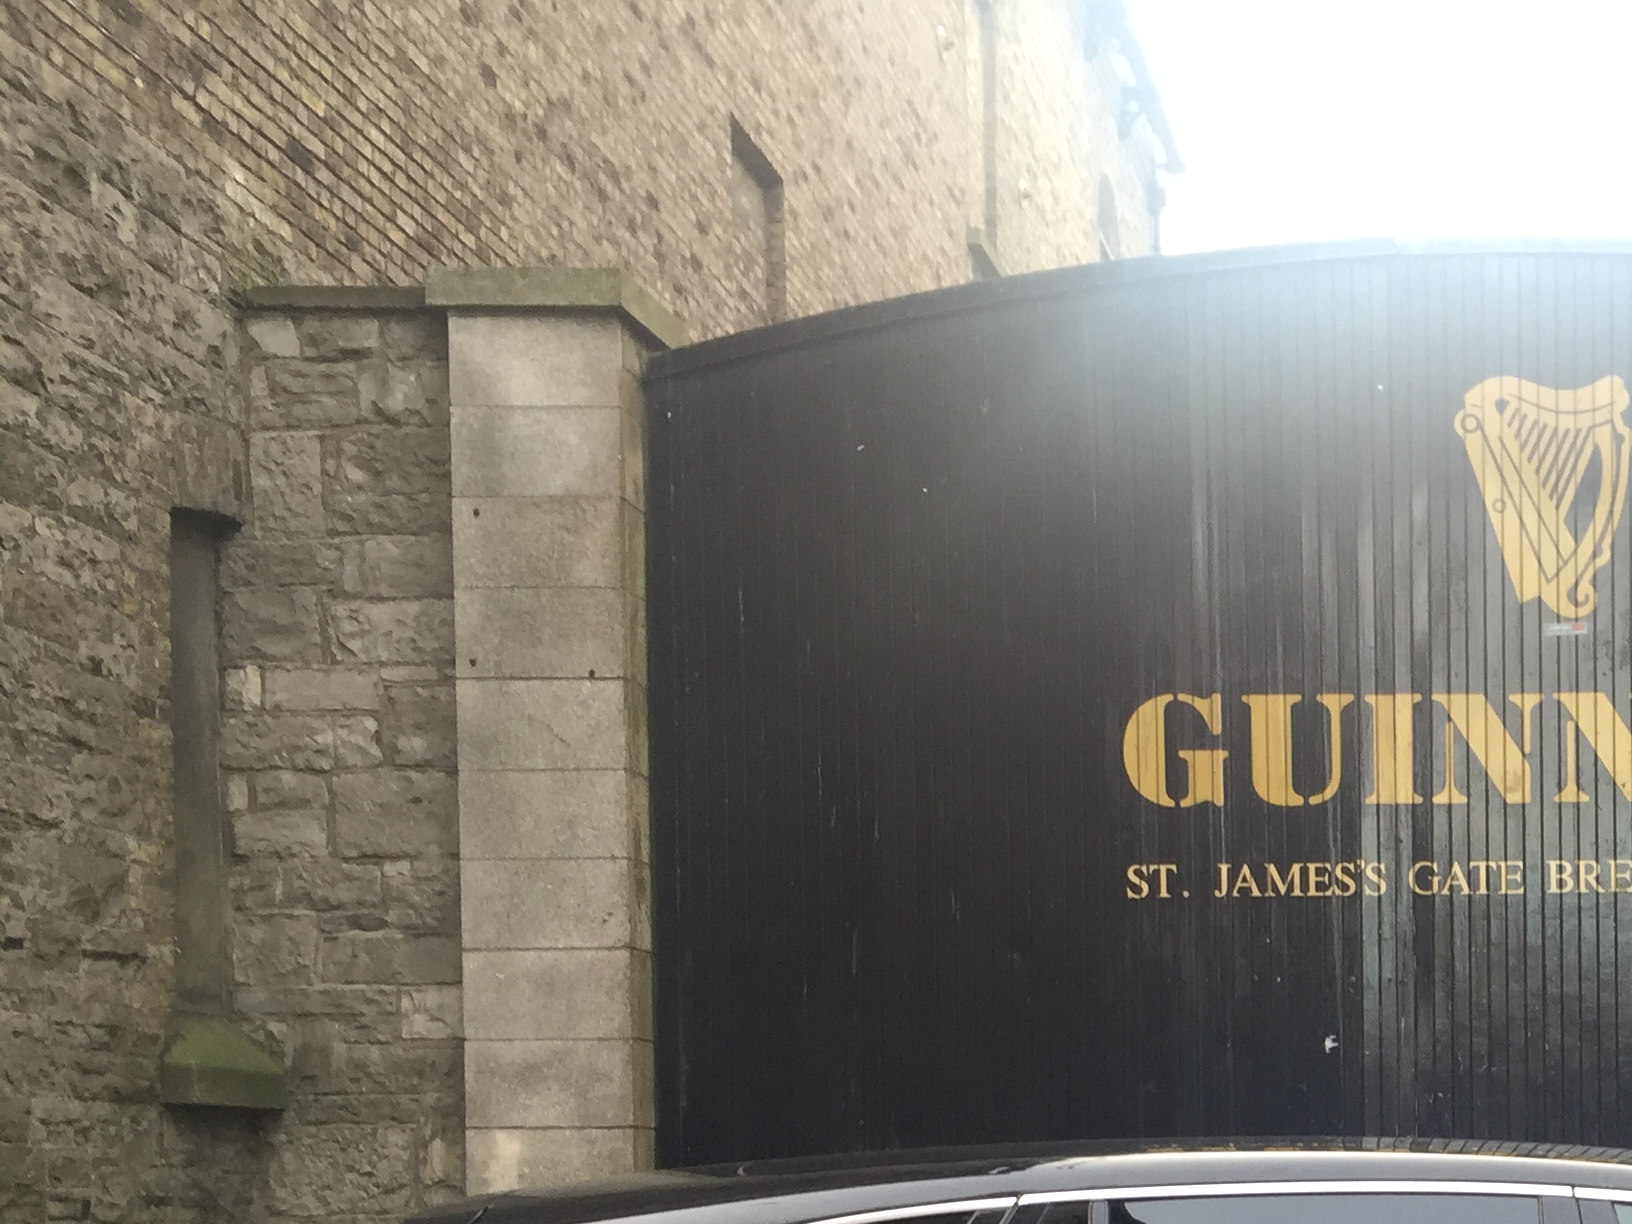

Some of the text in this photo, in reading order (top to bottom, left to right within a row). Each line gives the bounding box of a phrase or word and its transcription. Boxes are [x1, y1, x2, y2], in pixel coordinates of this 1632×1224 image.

[1126, 863, 1190, 899] ST.
[1214, 860, 1387, 897] JAMES'S
[1408, 859, 1525, 896] GATE
